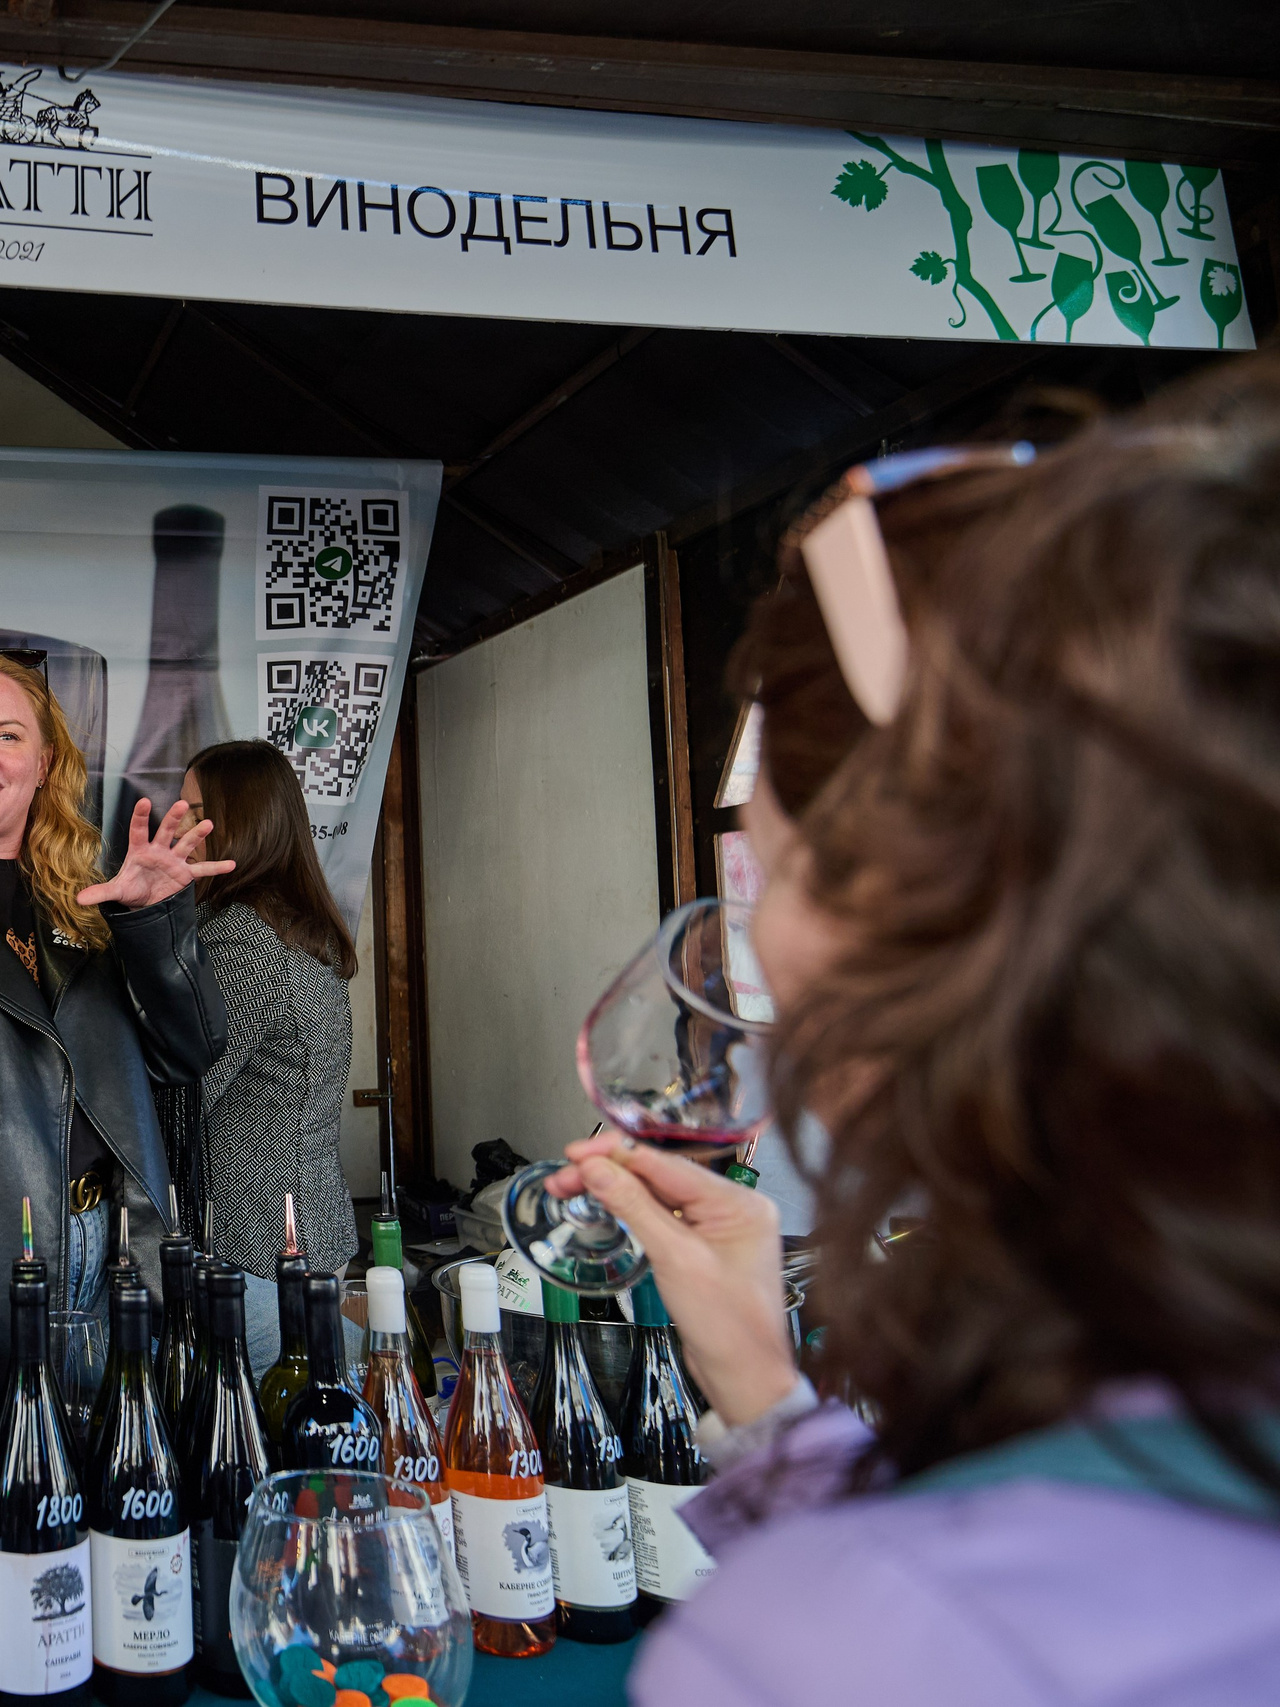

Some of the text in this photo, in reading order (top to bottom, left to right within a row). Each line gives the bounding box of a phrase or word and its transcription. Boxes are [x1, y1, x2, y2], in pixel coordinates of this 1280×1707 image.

[255, 171, 737, 258] ВИНОДЕЛЬНЯ
[328, 1434, 380, 1464] 1600
[394, 1455, 439, 1483] 1300
[36, 1492, 82, 1531] 1800
[121, 1486, 173, 1520] 1600
[133, 1629, 170, 1641] МЕРЛО
